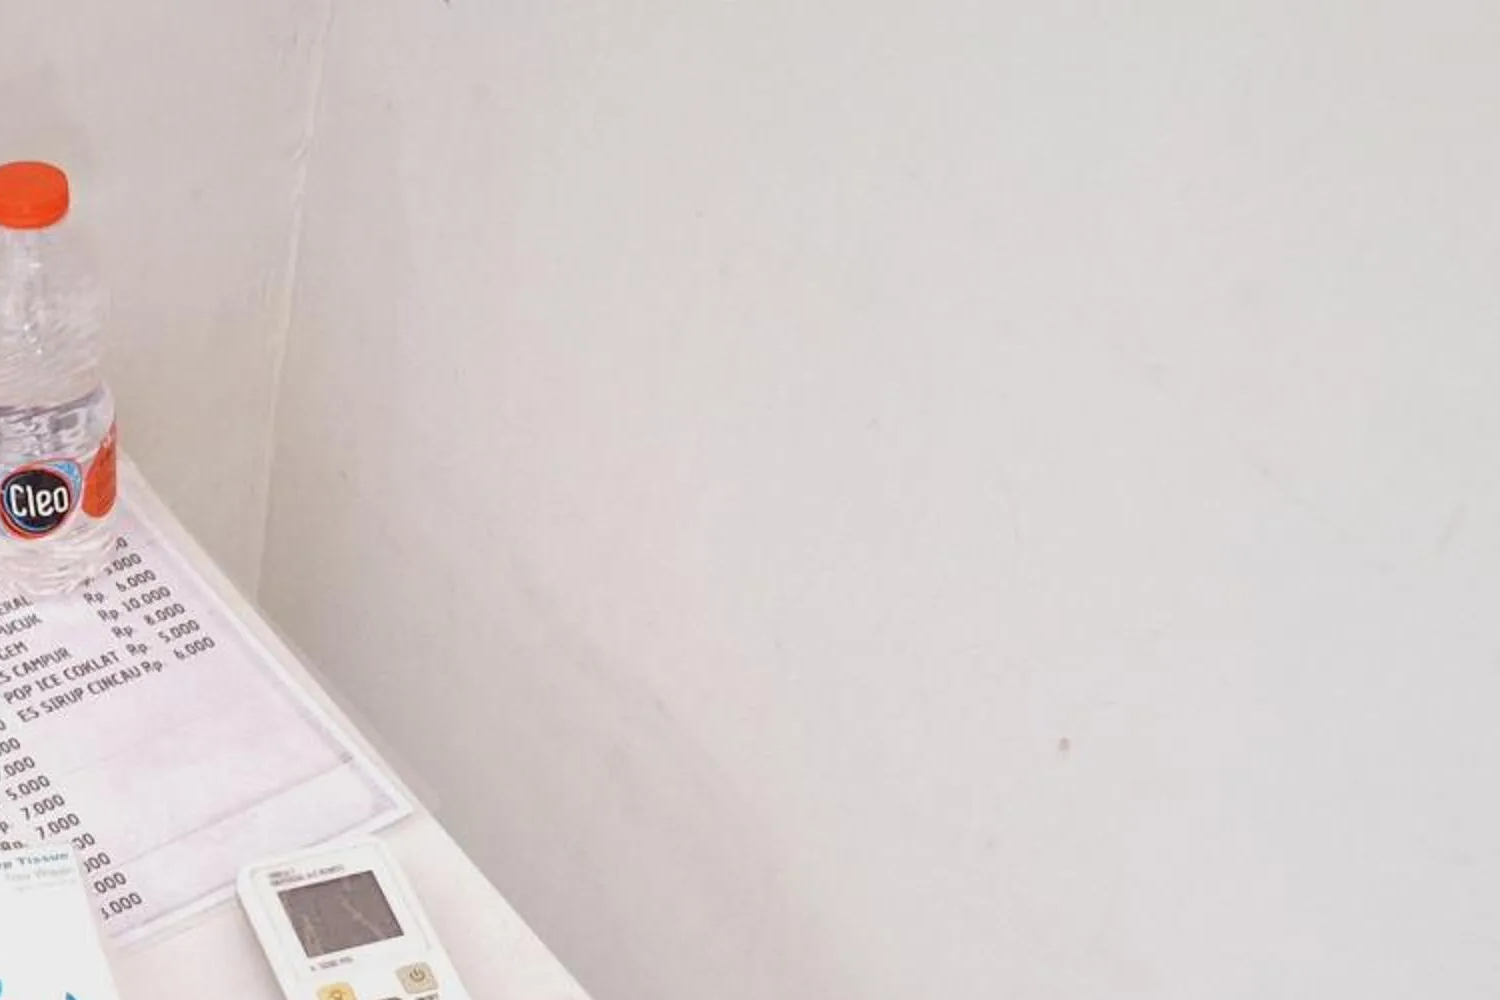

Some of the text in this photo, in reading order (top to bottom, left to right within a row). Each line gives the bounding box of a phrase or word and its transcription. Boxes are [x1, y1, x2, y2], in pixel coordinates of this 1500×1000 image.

[9, 484, 69, 518] Cleo
[3, 651, 119, 704] POP ICE COKLAT
[16, 706, 40, 723] ES
[40, 687, 84, 713] SIRUP
